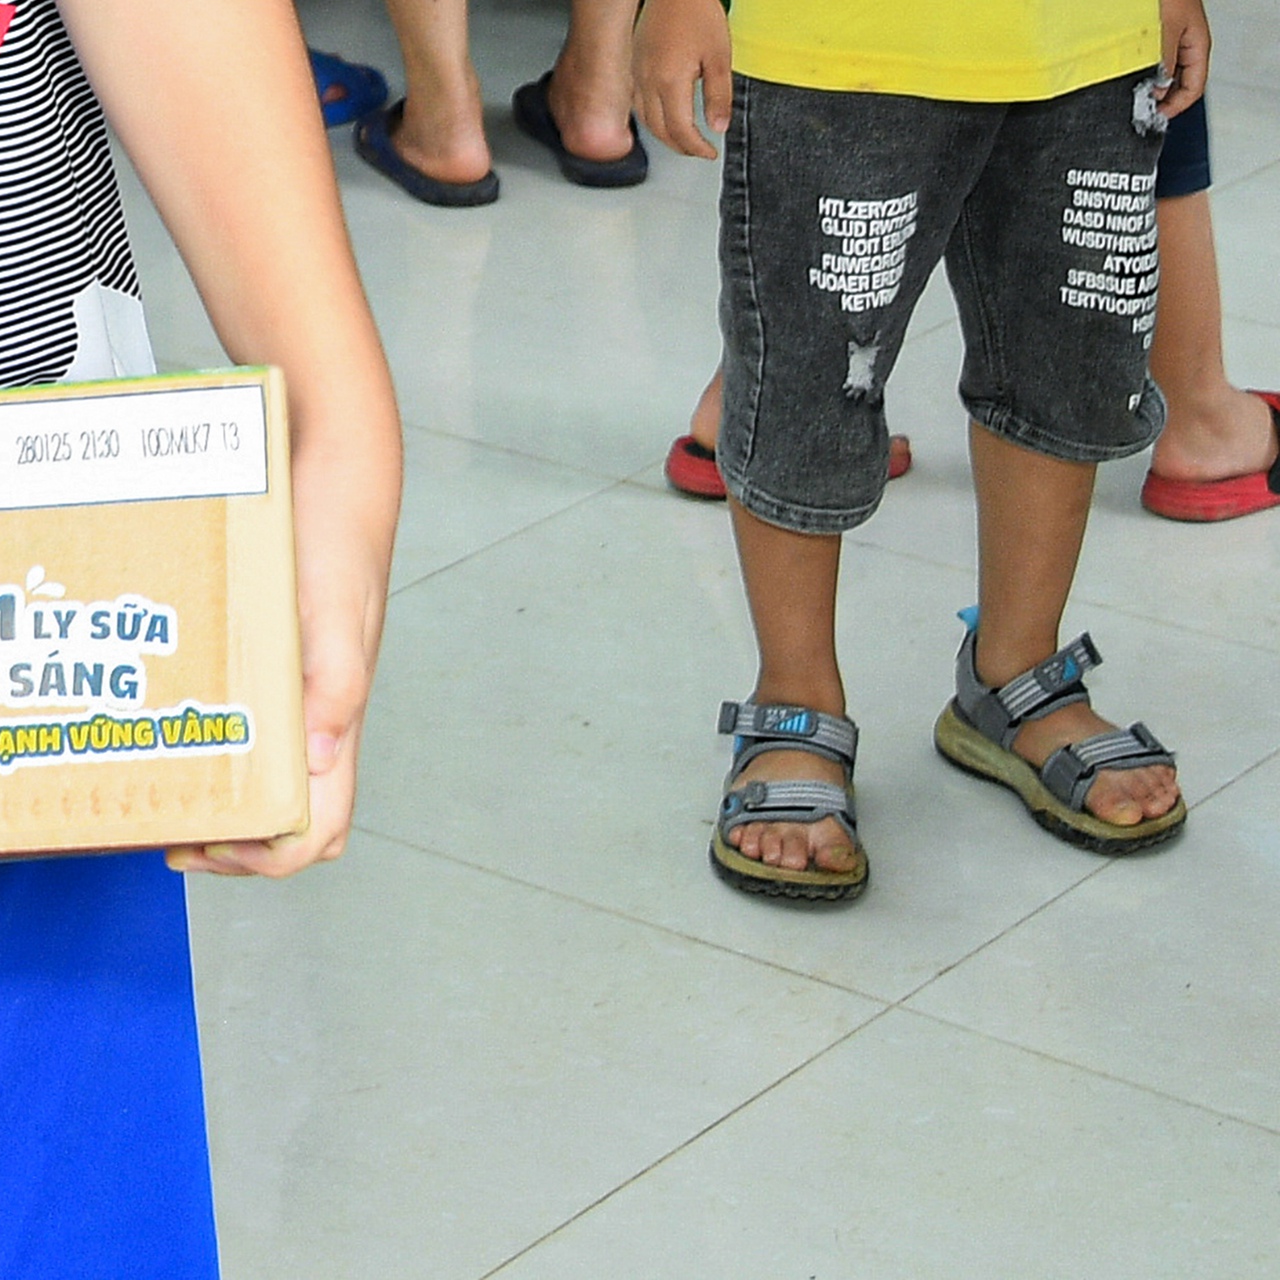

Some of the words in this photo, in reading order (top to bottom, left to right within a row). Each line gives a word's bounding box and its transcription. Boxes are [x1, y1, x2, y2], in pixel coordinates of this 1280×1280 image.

[33, 609, 77, 640] LY
[90, 602, 170, 645] SỮA
[8, 649, 140, 700] SÁNG
[68, 713, 156, 752] VỮNG
[160, 707, 250, 747] VÀNG
